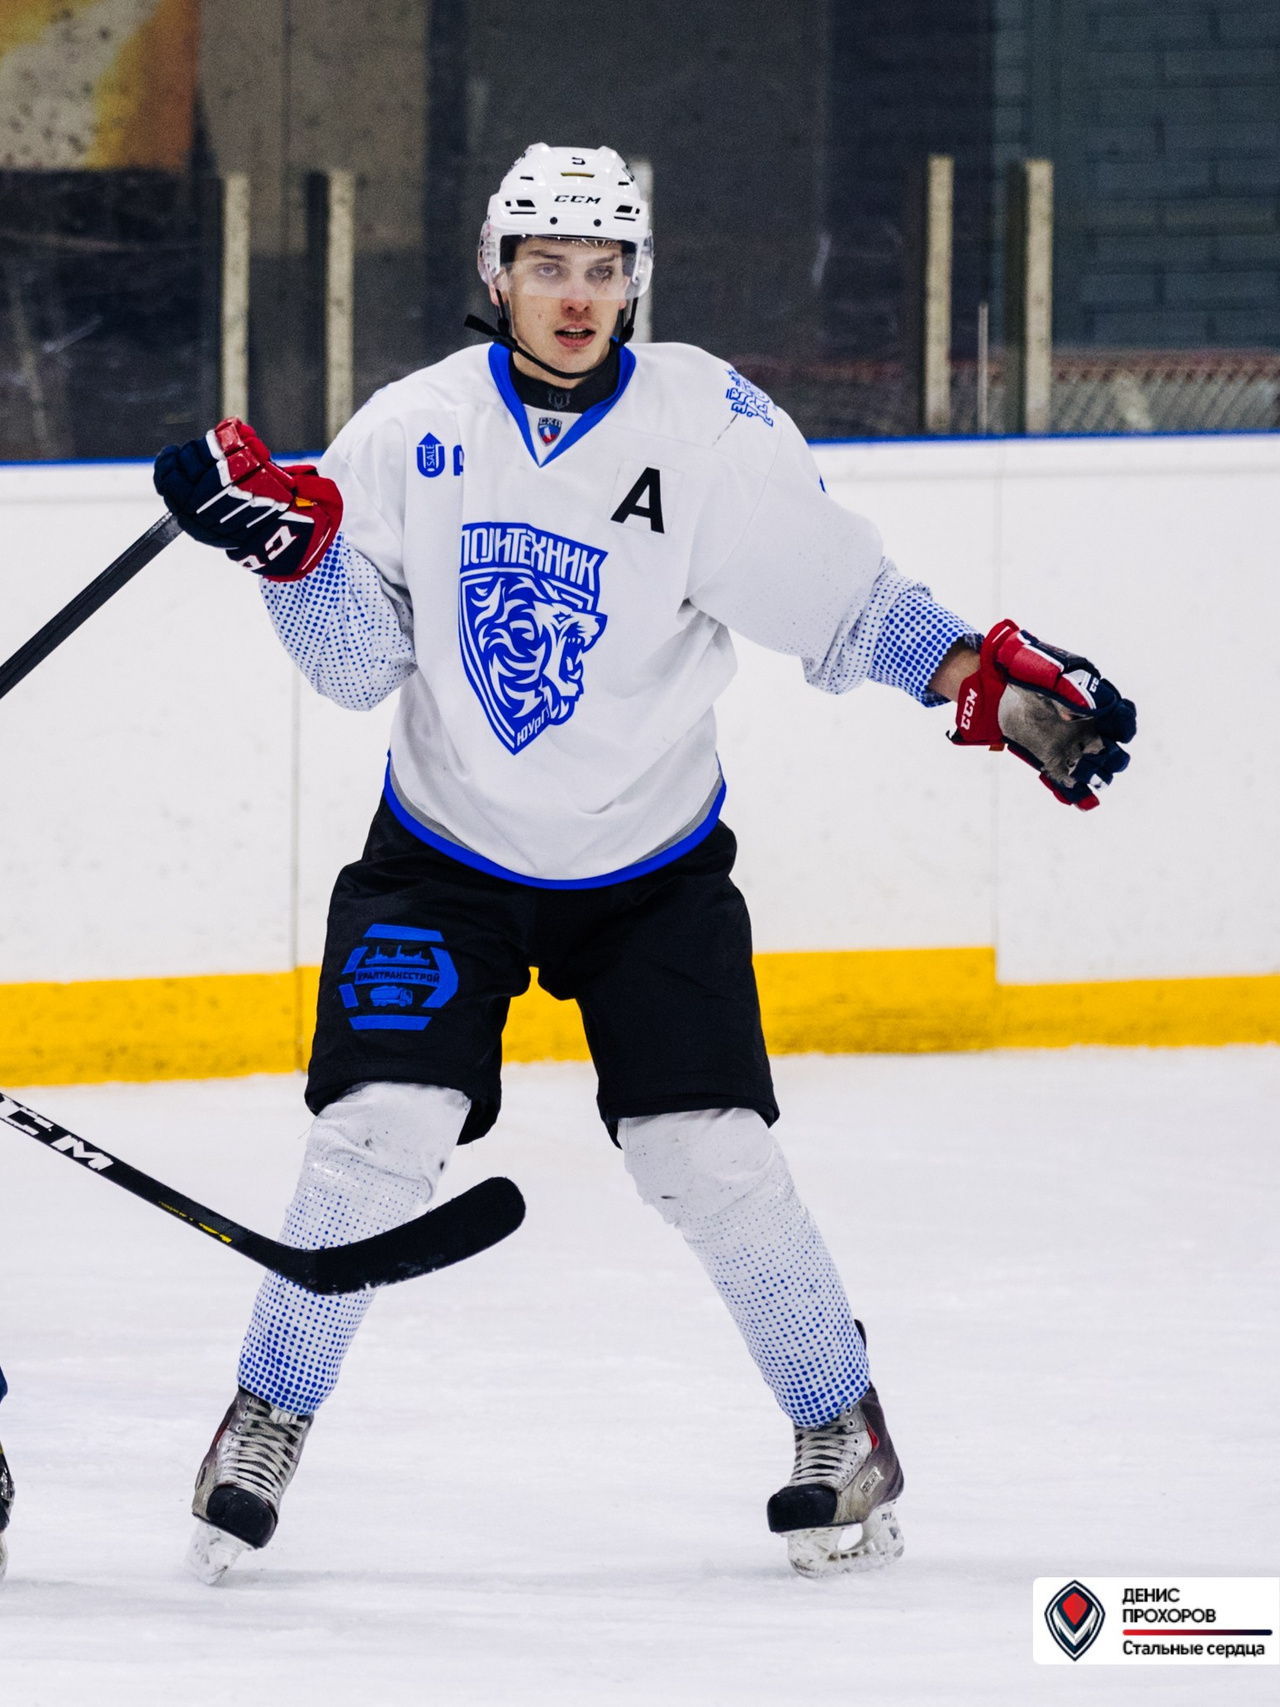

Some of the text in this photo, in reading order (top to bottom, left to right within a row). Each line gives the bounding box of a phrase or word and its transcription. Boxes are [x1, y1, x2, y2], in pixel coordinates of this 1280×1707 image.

[554, 195, 602, 205] CCM
[610, 467, 666, 534] A
[960, 688, 978, 730] CCM
